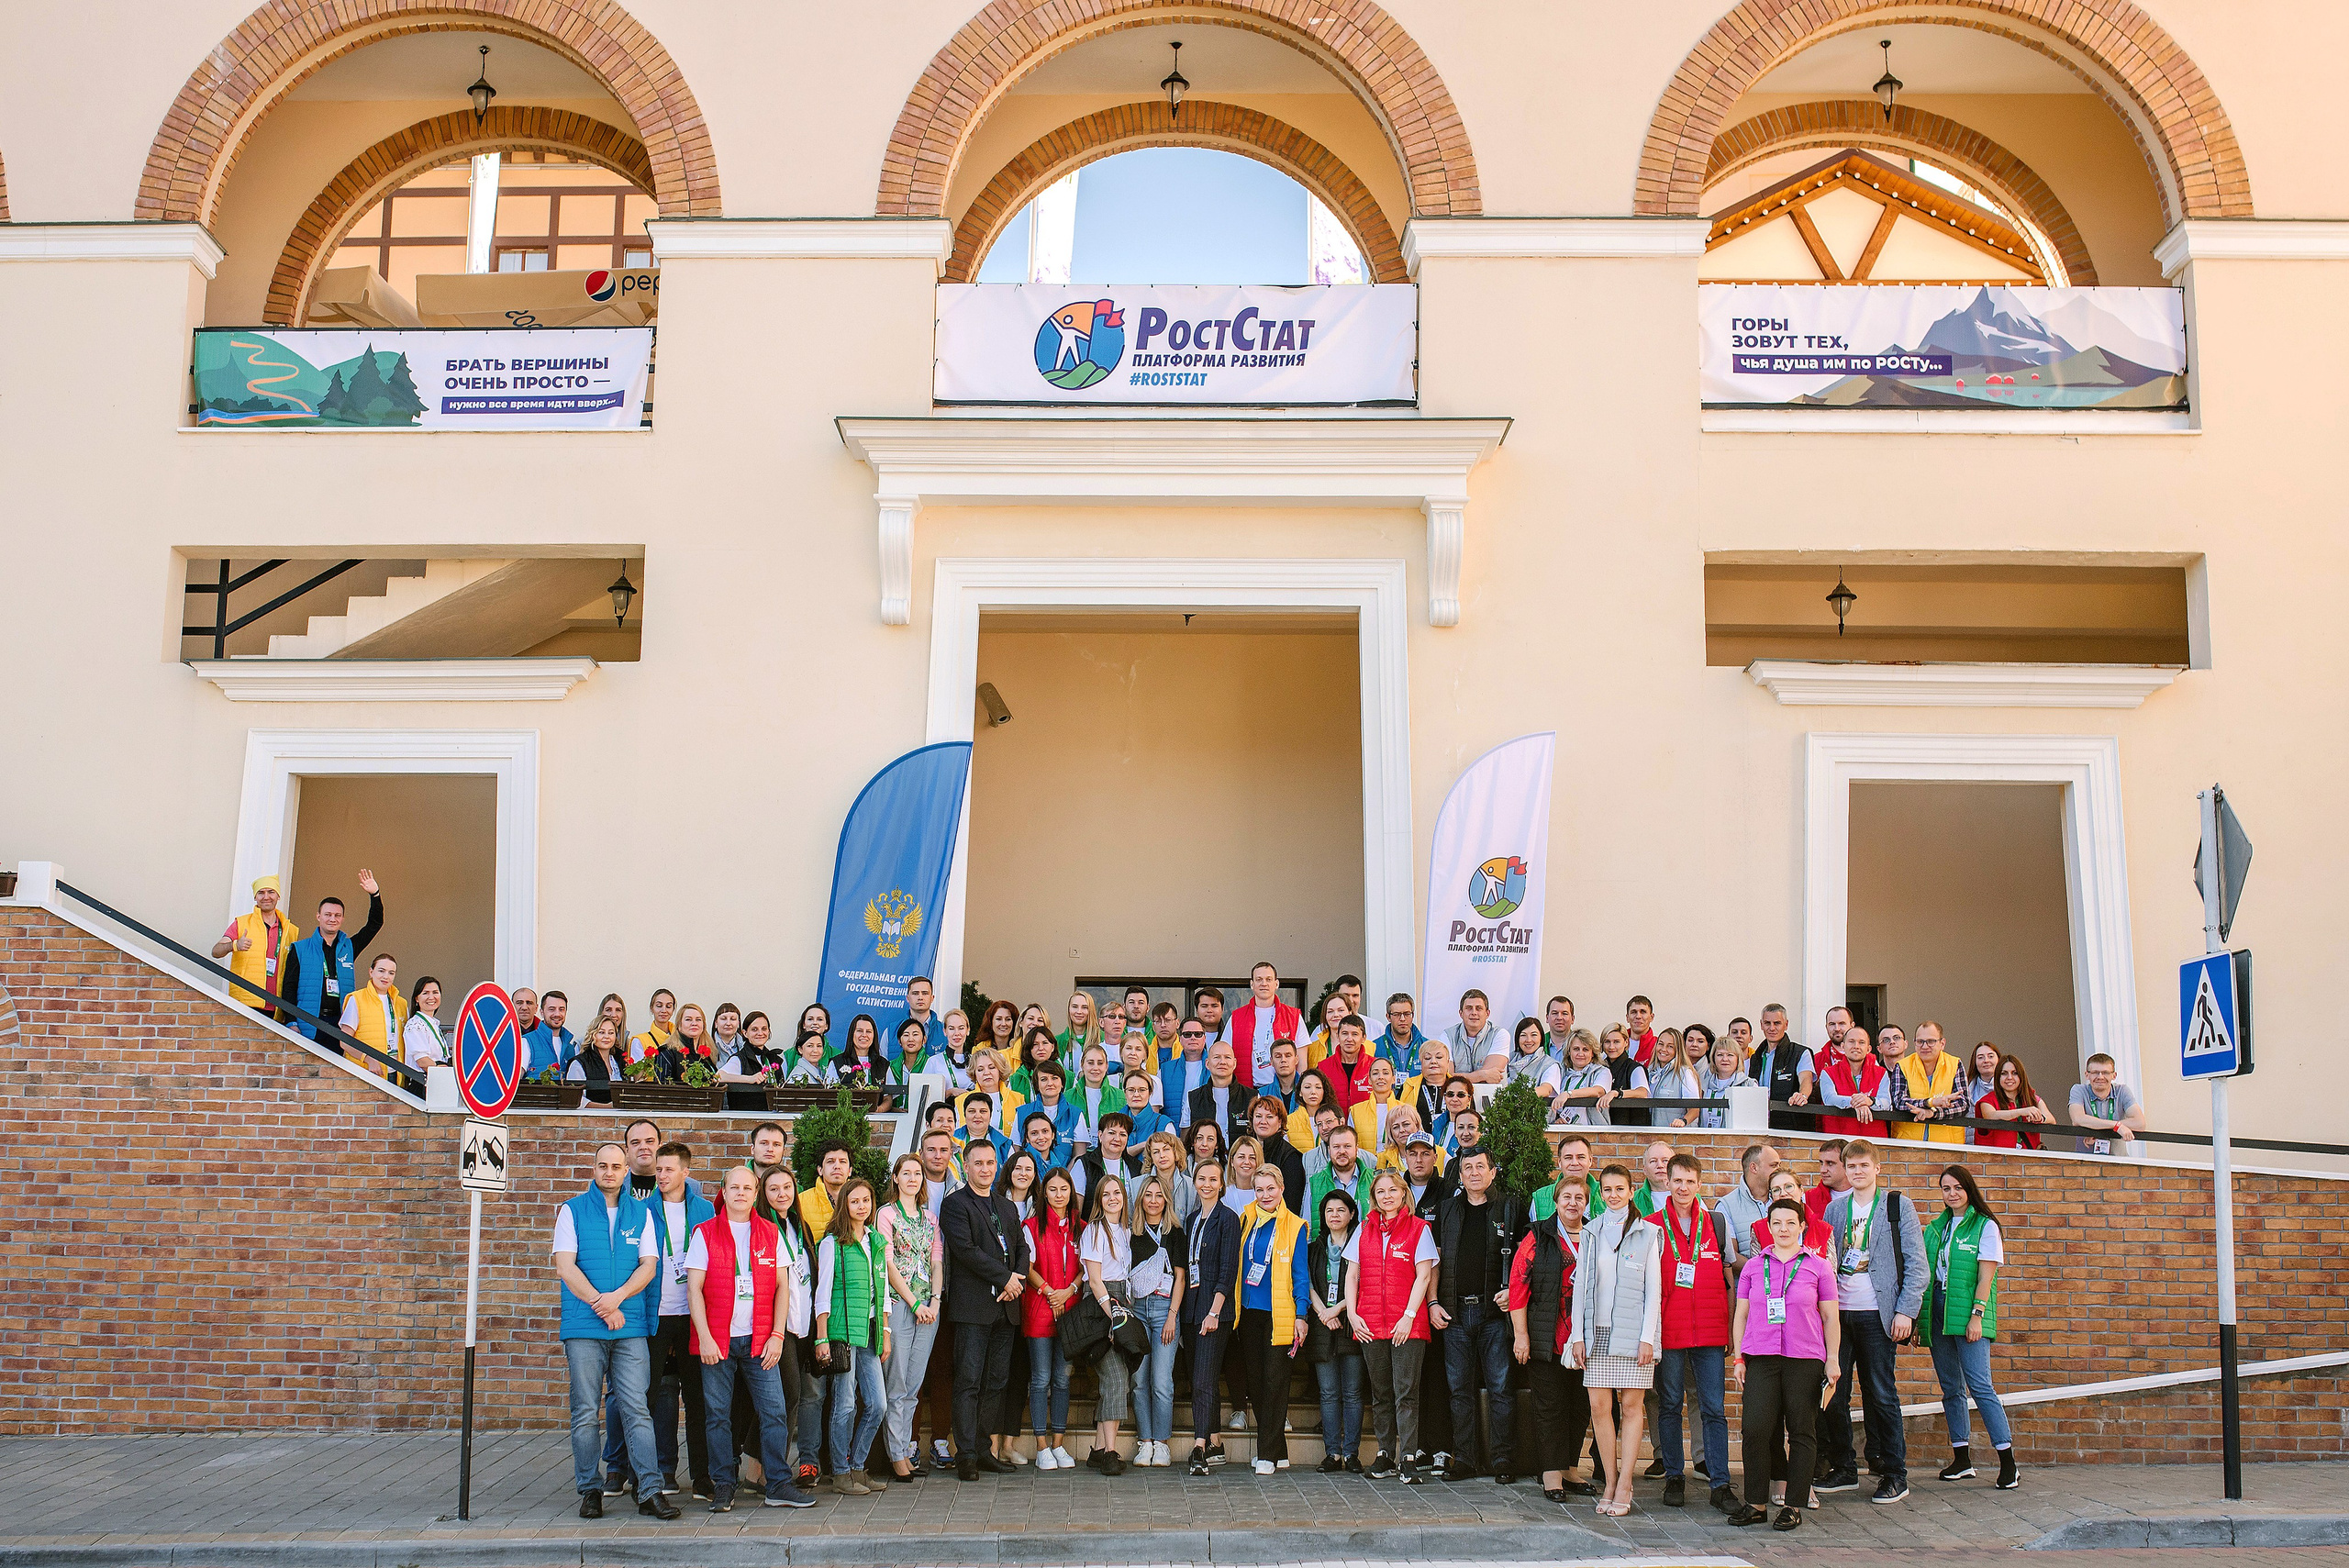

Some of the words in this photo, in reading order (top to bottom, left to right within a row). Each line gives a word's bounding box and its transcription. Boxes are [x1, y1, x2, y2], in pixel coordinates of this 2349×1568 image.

[1731, 317, 1788, 332] ГОРЫ
[1731, 335, 1798, 349] ЗОВУТ
[1804, 335, 1849, 351] ТЕХ,
[446, 359, 506, 372] БРАТЬ
[511, 357, 609, 371] ВЕРШИНЫ
[1131, 352, 1227, 368] ПЛАТФОРМА
[1230, 352, 1307, 368] РАЗВИТИЯ
[1740, 357, 1769, 371] чья
[1773, 357, 1820, 373] душа
[1823, 357, 1846, 370] им
[1850, 358, 1873, 371] по
[444, 377, 507, 390] ОЧЕНЬ
[513, 375, 589, 389] ПРОСТО
[1129, 372, 1208, 387] #ROSTSTAT
[450, 400, 486, 411] нужно
[488, 401, 507, 409] все
[510, 400, 544, 411] время
[547, 400, 575, 410] идти
[1447, 943, 1494, 952] ПЛАТФОРМА
[1496, 945, 1529, 954] РАЗВИТИЯ
[839, 970, 896, 983] ФЕДЕРАЛЬНАЯ
[856, 996, 905, 1008] СТАТИСТИКИ
